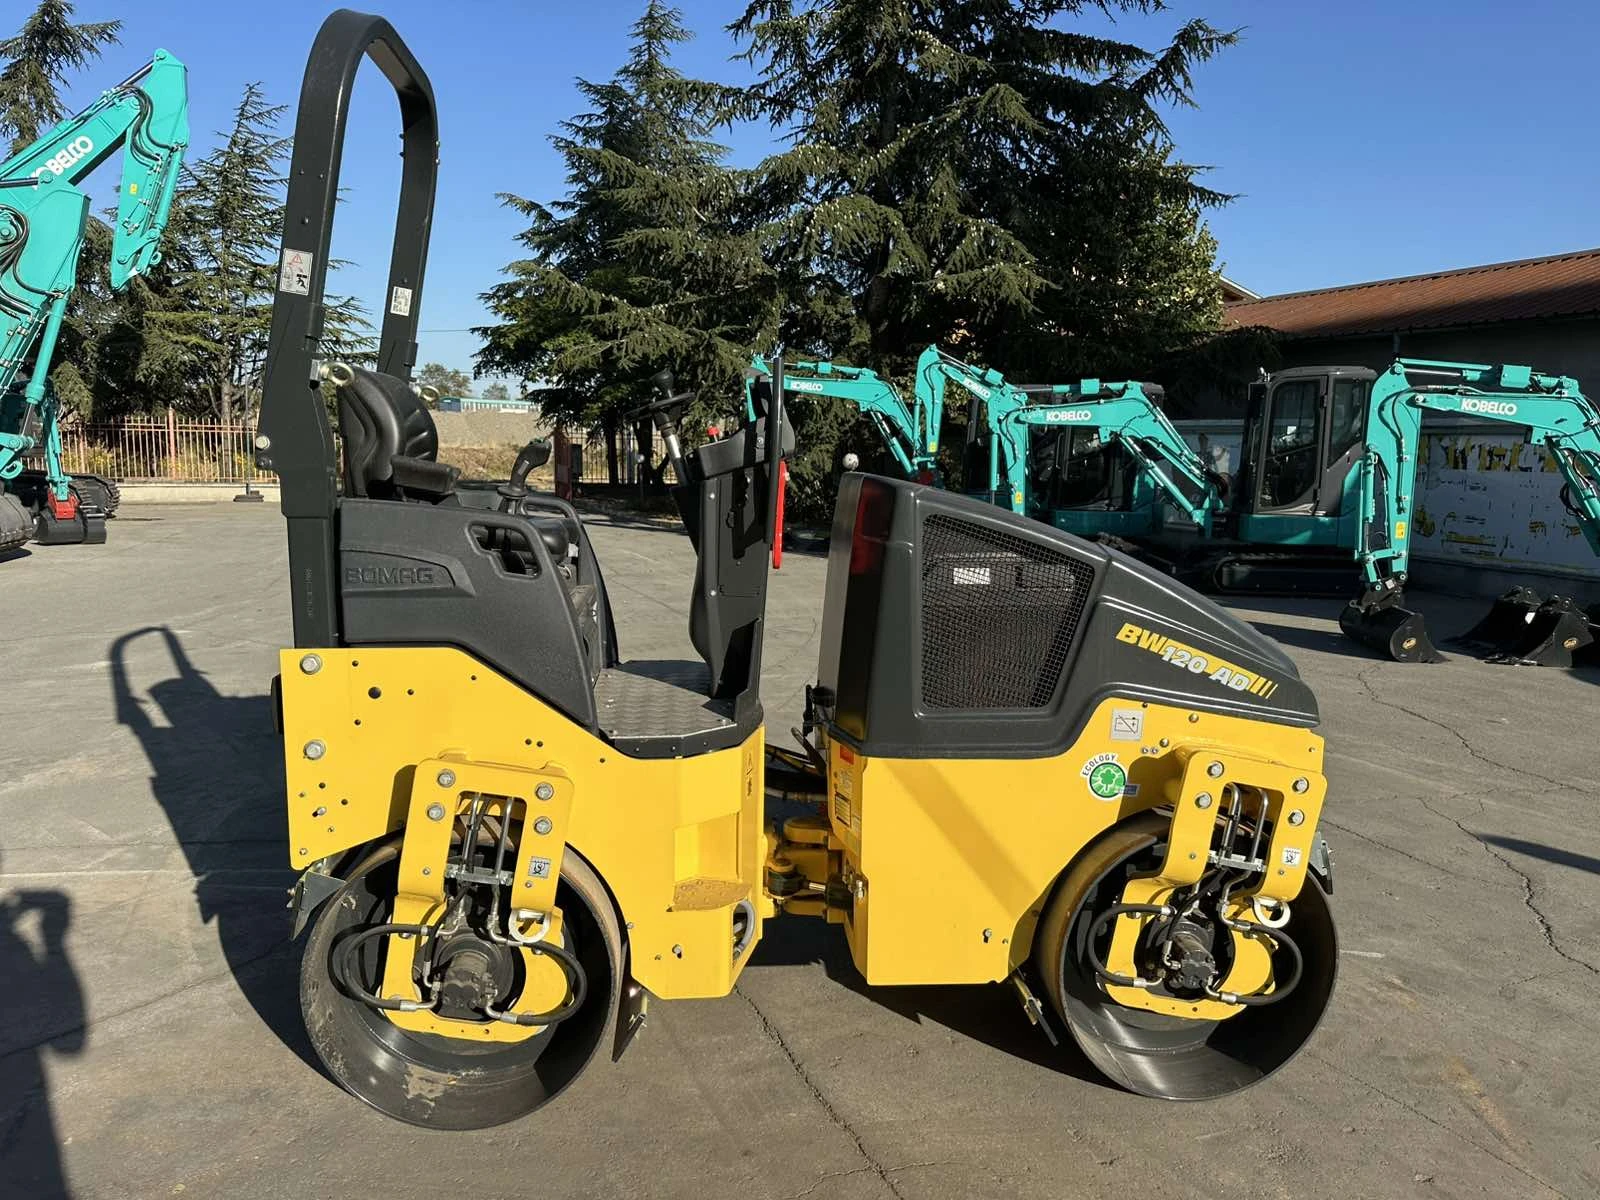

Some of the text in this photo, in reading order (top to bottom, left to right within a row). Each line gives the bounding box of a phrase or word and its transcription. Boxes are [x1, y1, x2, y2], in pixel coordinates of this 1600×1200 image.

[1046, 410, 1092, 422] KOBELCO
[1461, 398, 1518, 416] KOBELCO
[345, 567, 434, 585] BOMAG
[1208, 667, 1251, 692] AD
[1082, 753, 1116, 776] ECOLOGY
